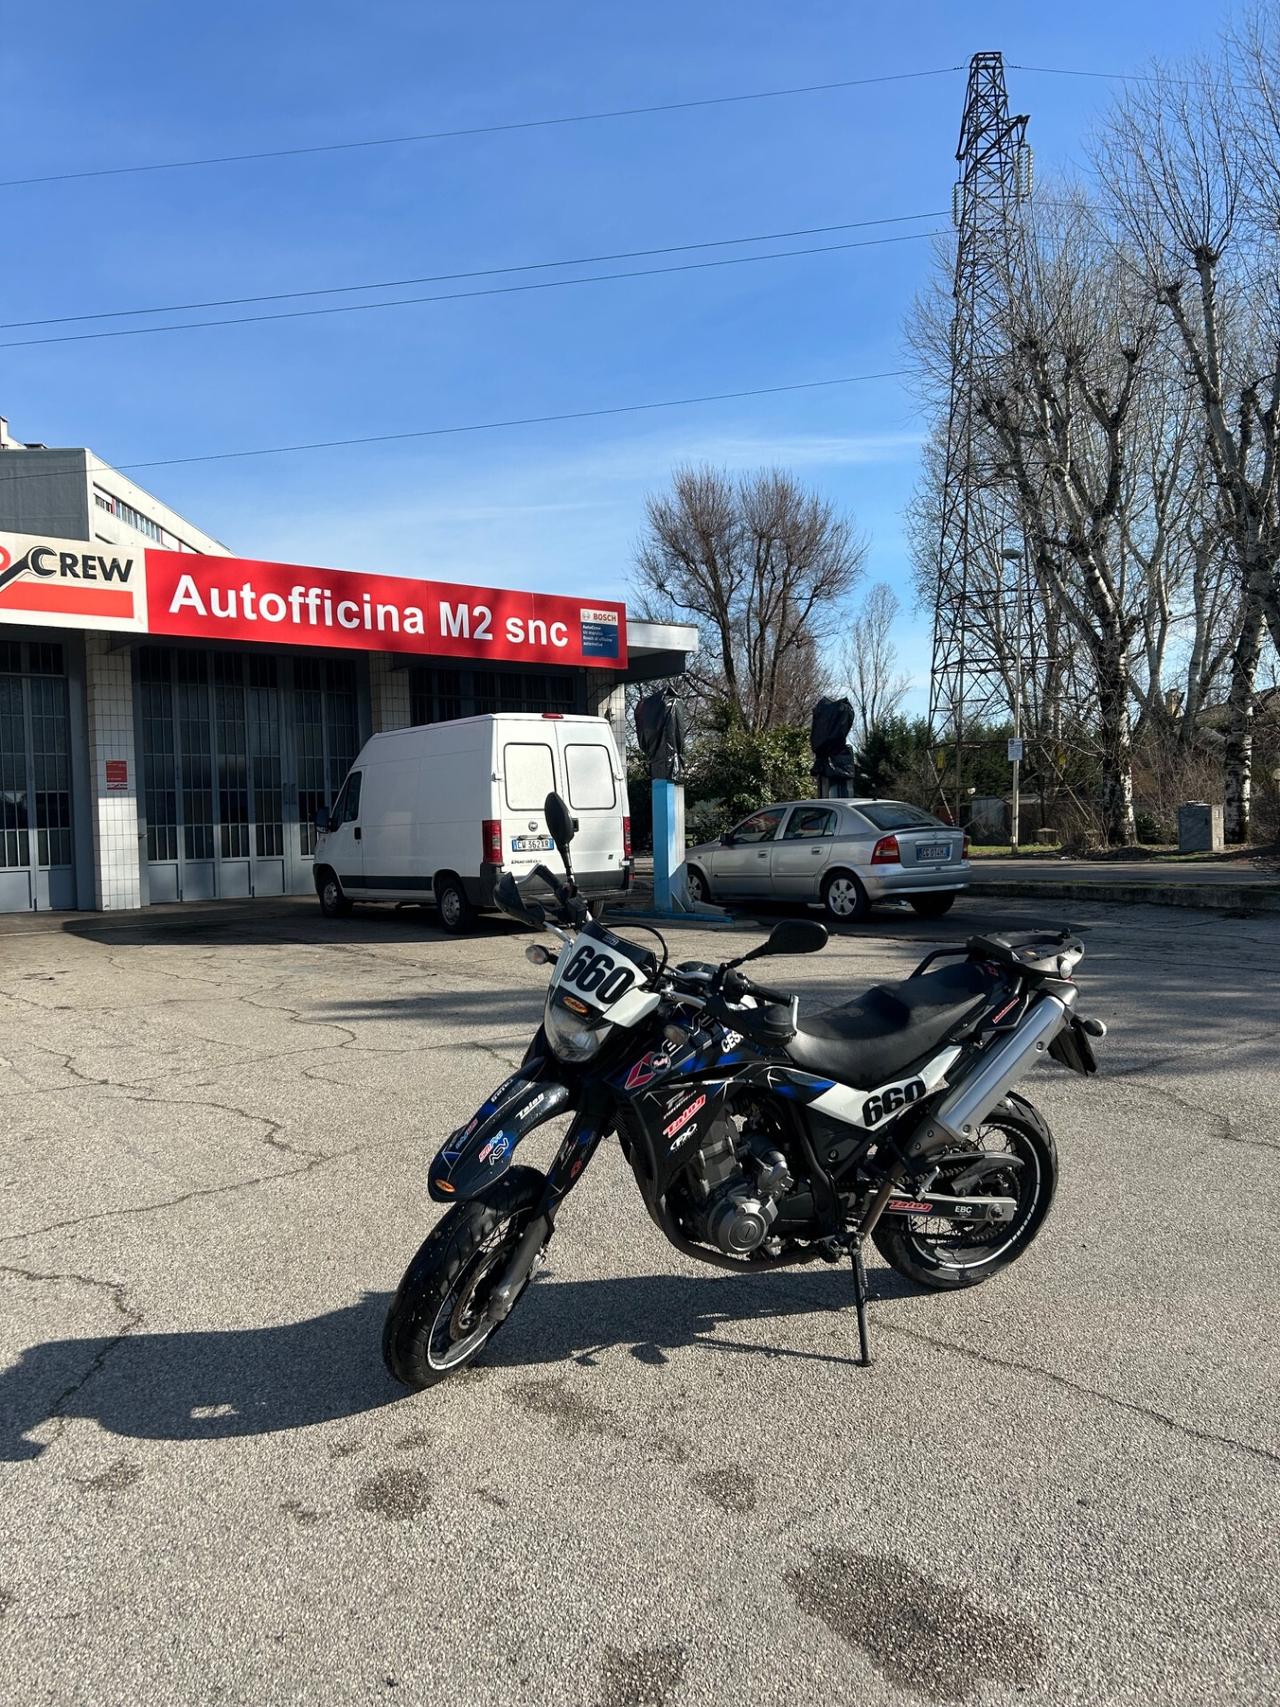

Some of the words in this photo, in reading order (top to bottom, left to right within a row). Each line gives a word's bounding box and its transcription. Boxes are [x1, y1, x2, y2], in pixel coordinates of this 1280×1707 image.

[28, 545, 134, 583] CREW
[168, 574, 425, 635] Autofficina
[439, 601, 494, 641] M2
[505, 616, 569, 648] snc
[593, 613, 616, 622] BOSCH
[562, 945, 635, 1005] 660
[862, 1080, 927, 1127] 660
[954, 1205, 973, 1214] EBC
